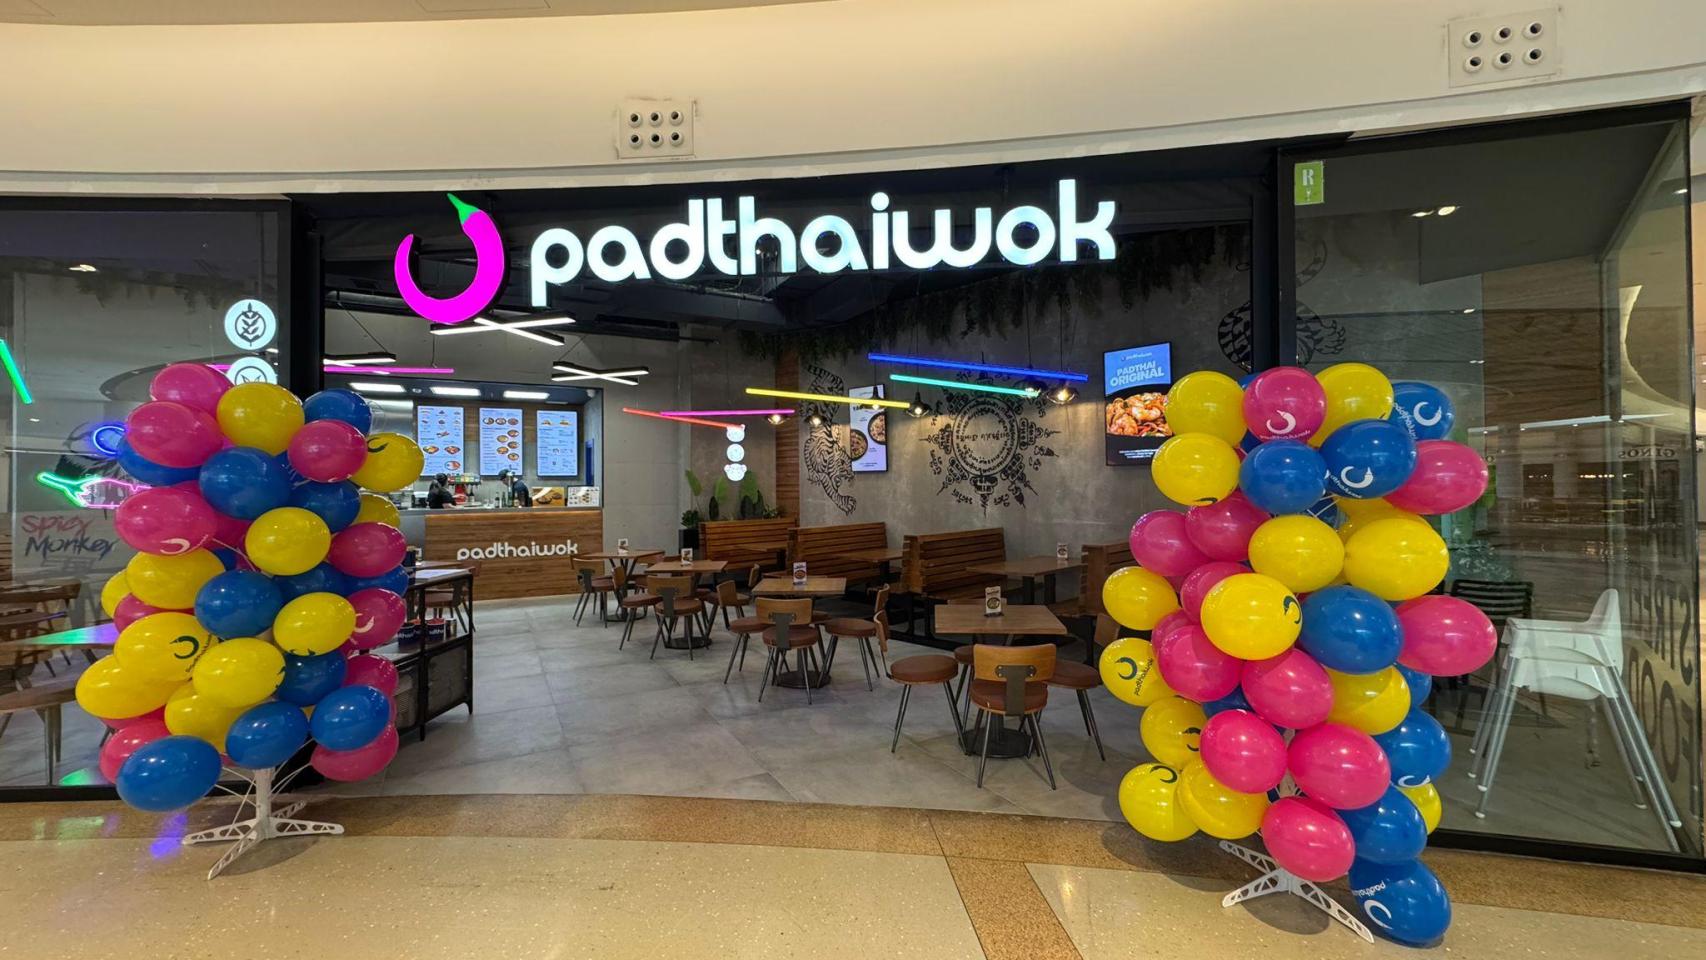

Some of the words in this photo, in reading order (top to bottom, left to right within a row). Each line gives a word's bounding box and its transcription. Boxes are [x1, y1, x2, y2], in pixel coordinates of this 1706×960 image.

[1302, 169, 1314, 186] R
[530, 178, 1117, 308] padthaiwok
[1110, 366, 1165, 387] ORIGINAL
[1117, 361, 1156, 376] PADTHAI
[25, 535, 120, 560] Monkey
[457, 539, 578, 560] padthaiwok
